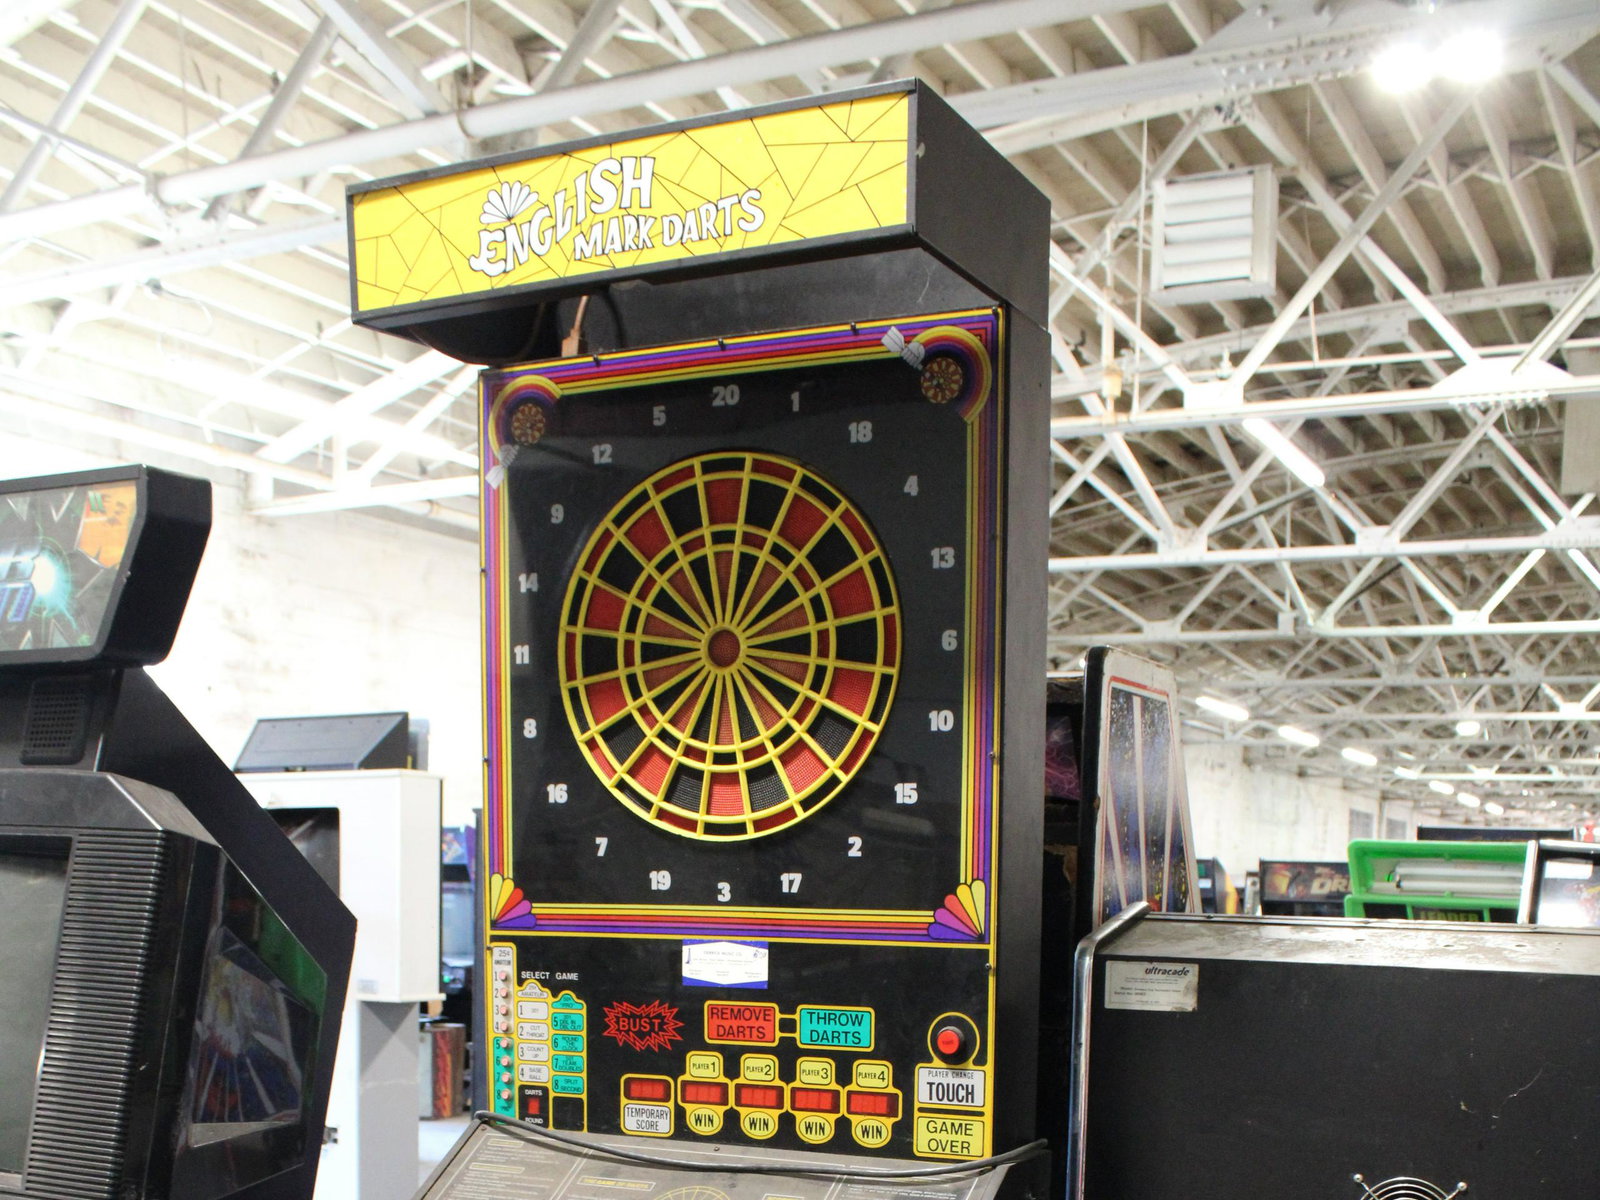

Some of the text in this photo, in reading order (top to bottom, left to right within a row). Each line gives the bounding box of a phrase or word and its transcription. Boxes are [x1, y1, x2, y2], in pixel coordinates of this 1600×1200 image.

[469, 156, 656, 277] ENGLISH
[574, 188, 765, 261] MARK DARTS
[712, 385, 740, 406] 20
[790, 391, 800, 411] 1
[653, 406, 667, 426] 5
[848, 421, 873, 442] 18
[592, 444, 613, 464] 12
[904, 476, 919, 496] 4
[551, 504, 564, 524] 9
[931, 547, 956, 568] 13
[518, 573, 538, 593] 14
[941, 629, 957, 651] 6
[514, 644, 530, 664] 11
[523, 718, 537, 738] 8
[929, 710, 954, 731] 10
[547, 784, 568, 804] 16
[895, 783, 918, 804] 15
[596, 837, 608, 856] 7
[848, 837, 862, 857] 2
[650, 871, 671, 891] 19
[780, 873, 802, 893] 17
[717, 882, 731, 902] 3
[521, 971, 579, 980] SELECT GAME
[1145, 966, 1190, 976] ultracade
[494, 989, 499, 998] 2
[495, 1006, 499, 1015] 3
[519, 1005, 523, 1015] 1
[710, 1007, 772, 1022] REMOVE
[495, 1022, 499, 1030] 4
[553, 1017, 558, 1027] 5
[619, 1018, 661, 1032] BUST
[806, 1011, 864, 1027] THROW
[519, 1026, 524, 1037] 2
[716, 1025, 766, 1039] DARTS
[810, 1029, 862, 1045] DARTS
[553, 1038, 558, 1048] 6
[520, 1047, 524, 1057] 3
[554, 1058, 558, 1069] 7
[711, 1062, 716, 1072] 1
[764, 1065, 772, 1076] 2
[520, 1068, 524, 1077] 4
[802, 1067, 829, 1079] PLAYER 3
[877, 1070, 886, 1082] 4
[928, 1069, 974, 1080] PLAYER CHANGE
[554, 1079, 558, 1089] 8
[927, 1081, 975, 1104] TOUCH
[626, 1106, 669, 1120] TEMPORARY
[694, 1113, 714, 1128] WIN
[636, 1119, 660, 1131] SCORE
[748, 1117, 769, 1131] WIN
[804, 1121, 825, 1136] WIN
[926, 1120, 973, 1136] GAME
[860, 1125, 882, 1139] WIN
[927, 1138, 971, 1154] OVER
